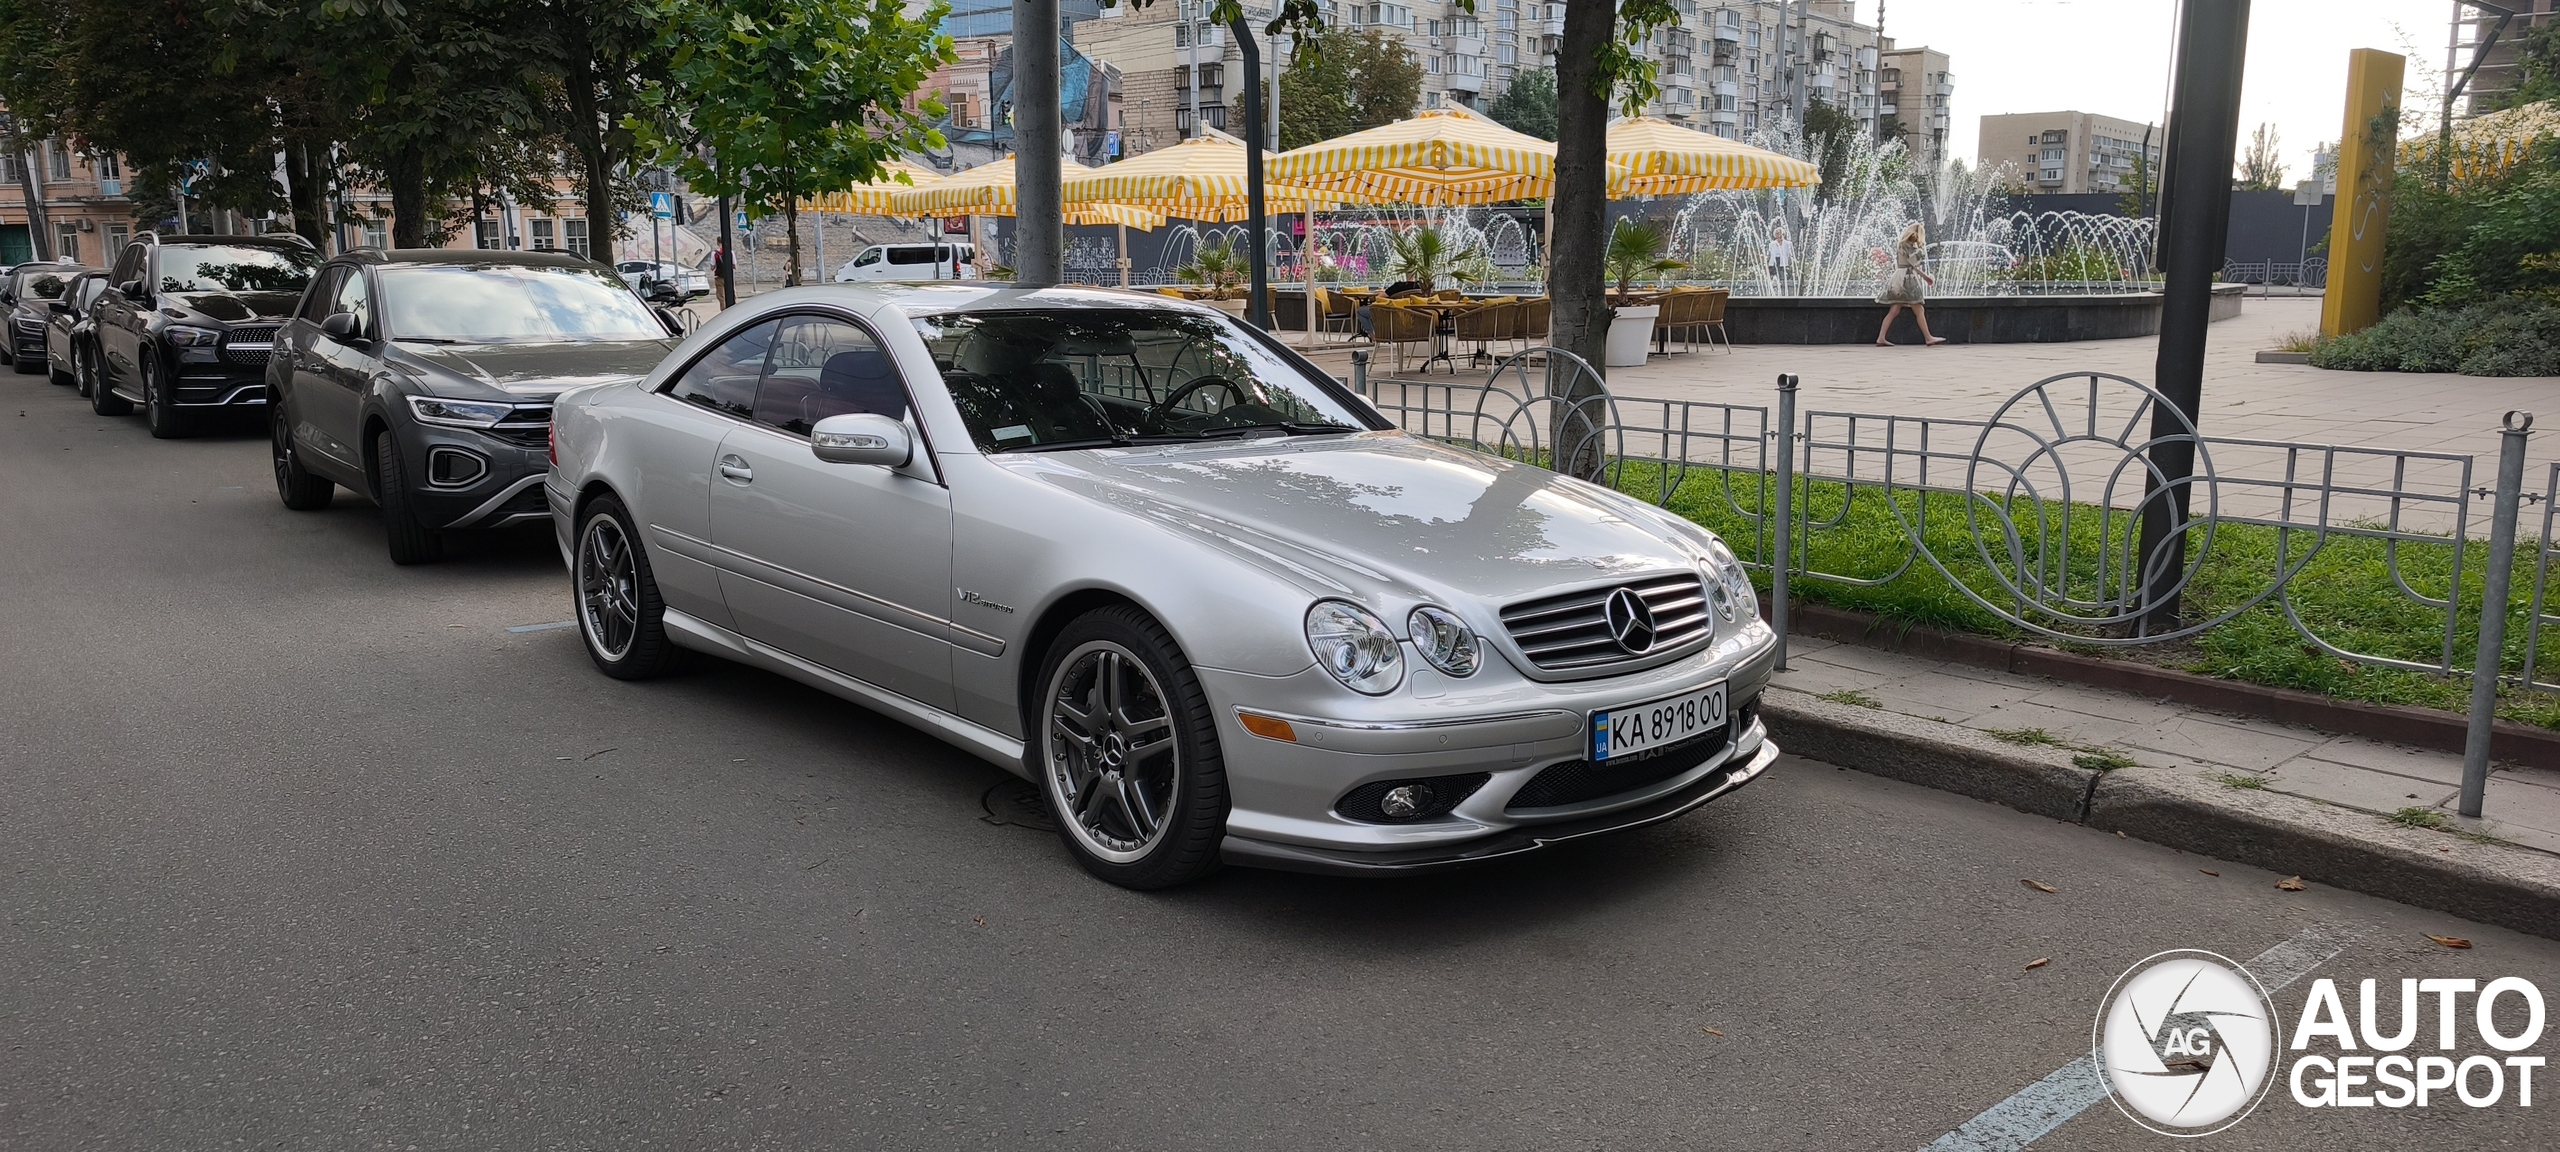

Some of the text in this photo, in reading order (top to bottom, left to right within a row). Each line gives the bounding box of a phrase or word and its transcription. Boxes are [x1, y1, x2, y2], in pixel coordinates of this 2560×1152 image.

[956, 587, 980, 605] V12
[1611, 713, 1646, 751] KA
[1651, 699, 1695, 741] 8918
[1596, 742, 1608, 754] UA
